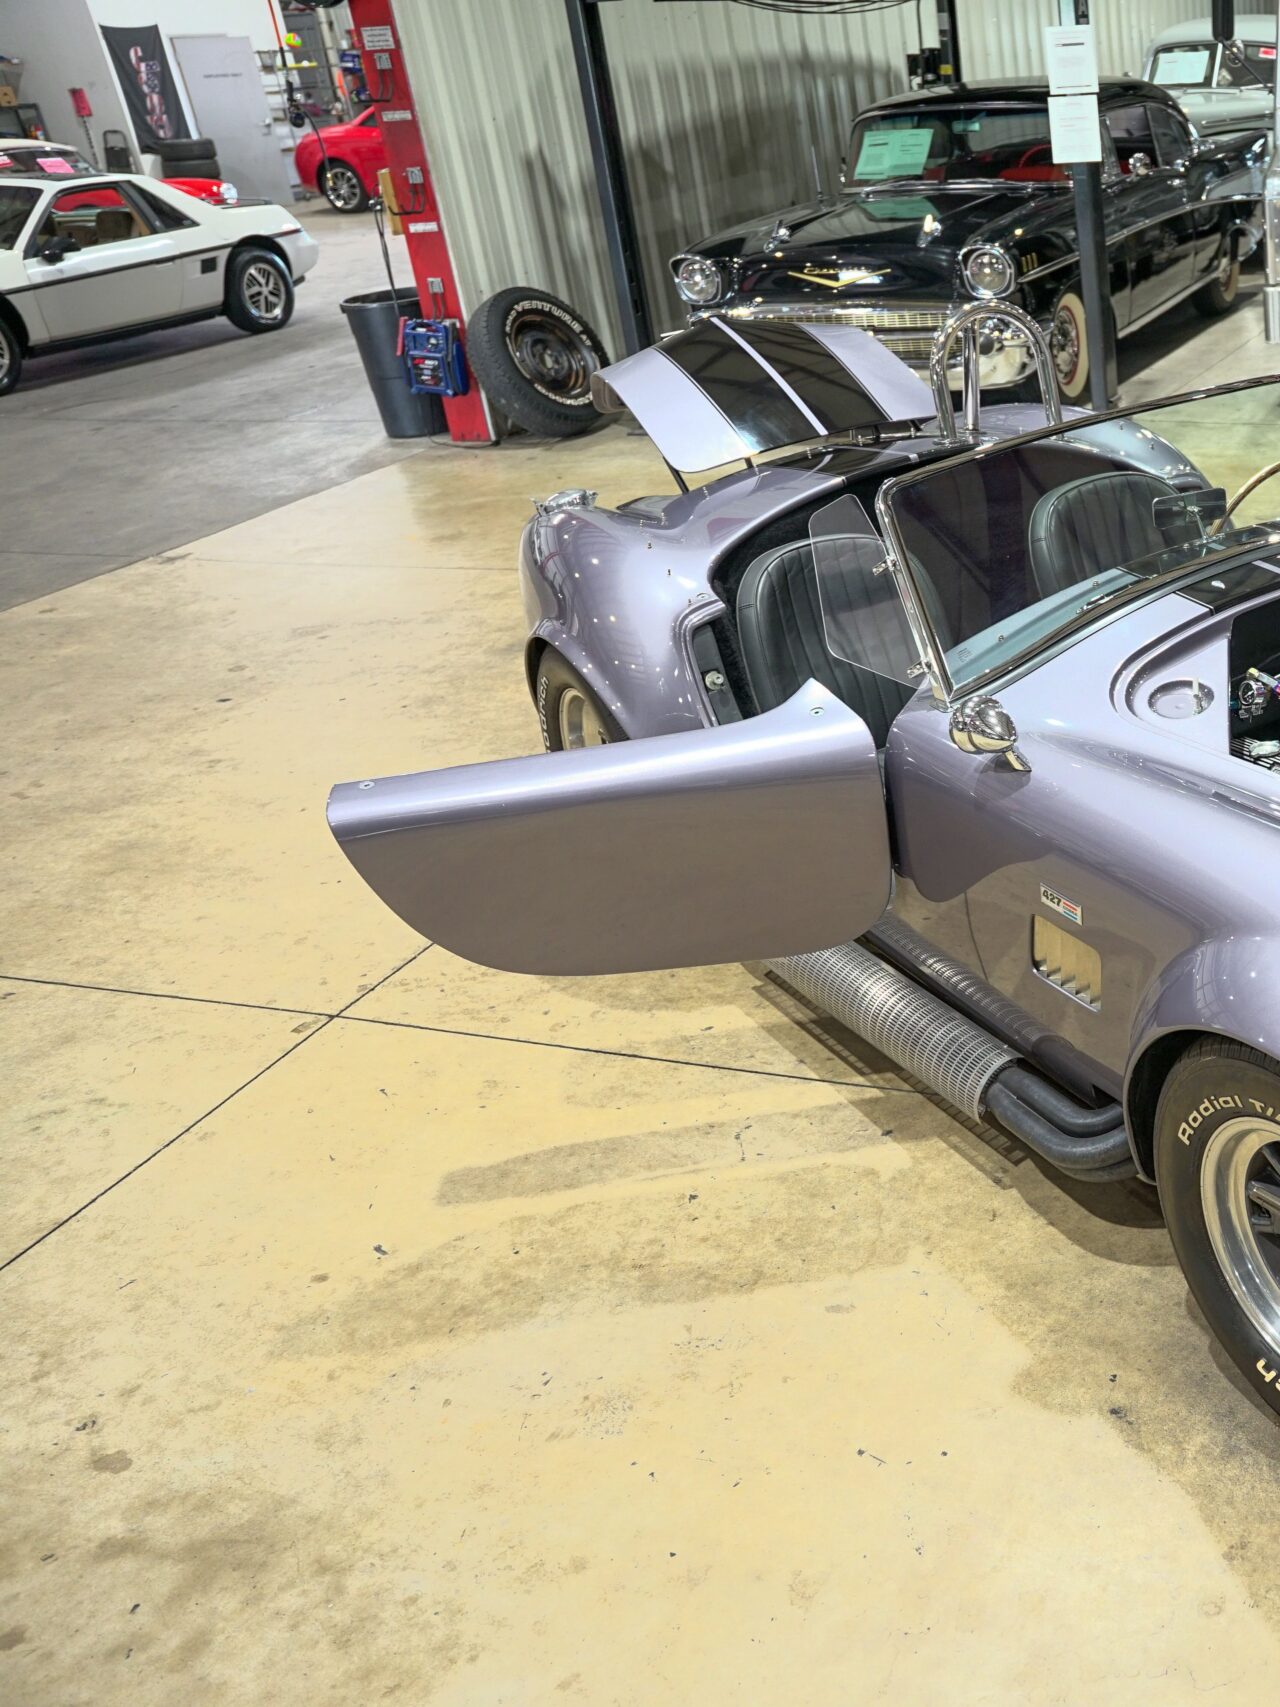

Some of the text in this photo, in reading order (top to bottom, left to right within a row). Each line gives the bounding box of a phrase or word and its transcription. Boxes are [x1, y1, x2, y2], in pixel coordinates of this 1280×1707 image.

[513, 300, 584, 334] VENTURE
[1042, 889, 1062, 906] 427
[1178, 1095, 1243, 1146] Radial
